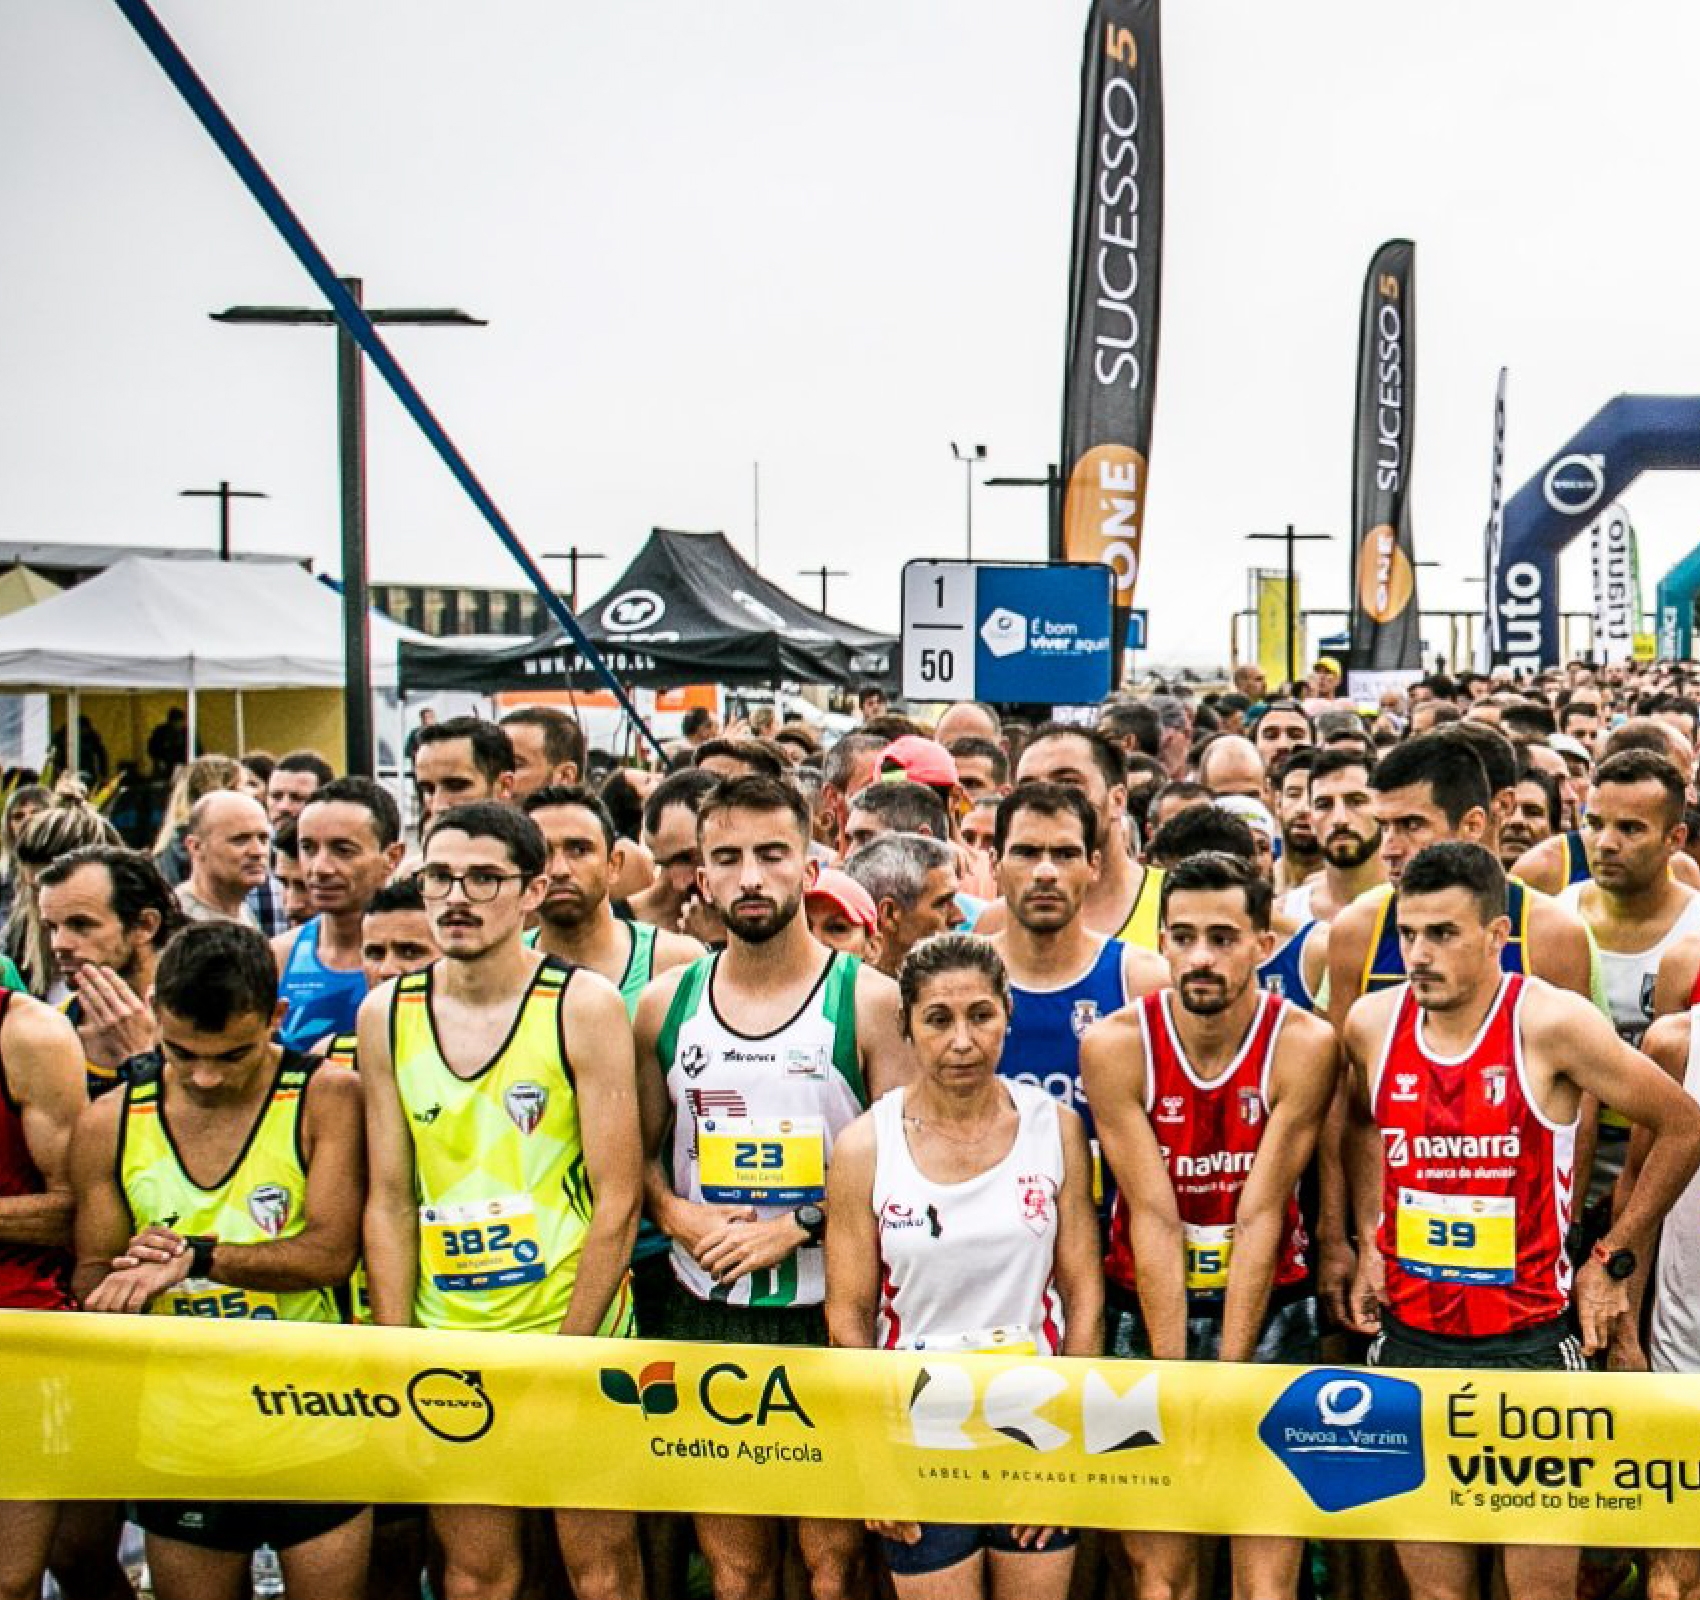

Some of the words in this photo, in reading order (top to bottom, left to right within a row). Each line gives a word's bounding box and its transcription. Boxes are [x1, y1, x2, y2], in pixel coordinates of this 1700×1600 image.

[1106, 22, 1137, 68] 5
[1095, 78, 1140, 389] SUCESSO
[1379, 273, 1399, 299] 5
[1376, 305, 1400, 491] SUCESSO
[1100, 460, 1137, 592] ONE
[1376, 534, 1393, 613] ONE
[934, 575, 945, 609] 1
[920, 649, 954, 683] 50
[734, 1142, 784, 1168] 23
[442, 1223, 513, 1257] 382
[1427, 1218, 1476, 1249] 39
[251, 1384, 402, 1418] triauto
[420, 1398, 483, 1409] VOLVO
[699, 1361, 816, 1429] CA
[1448, 1382, 1478, 1439] É
[1499, 1392, 1615, 1440] bom
[650, 1436, 729, 1459] Crédito
[737, 1440, 822, 1464] Agrícola
[1284, 1427, 1337, 1444] Póvoa
[1349, 1428, 1408, 1445] Varzim
[918, 1466, 971, 1480] LABEL
[982, 1470, 990, 1481] &
[1001, 1469, 1076, 1483] PACKAGE
[1088, 1473, 1171, 1487] PRINTING
[1447, 1445, 1596, 1488] viver
[1491, 1491, 1536, 1512] good
[1541, 1493, 1562, 1508] to
[1568, 1491, 1590, 1509] be
[1596, 1492, 1642, 1510] here!
